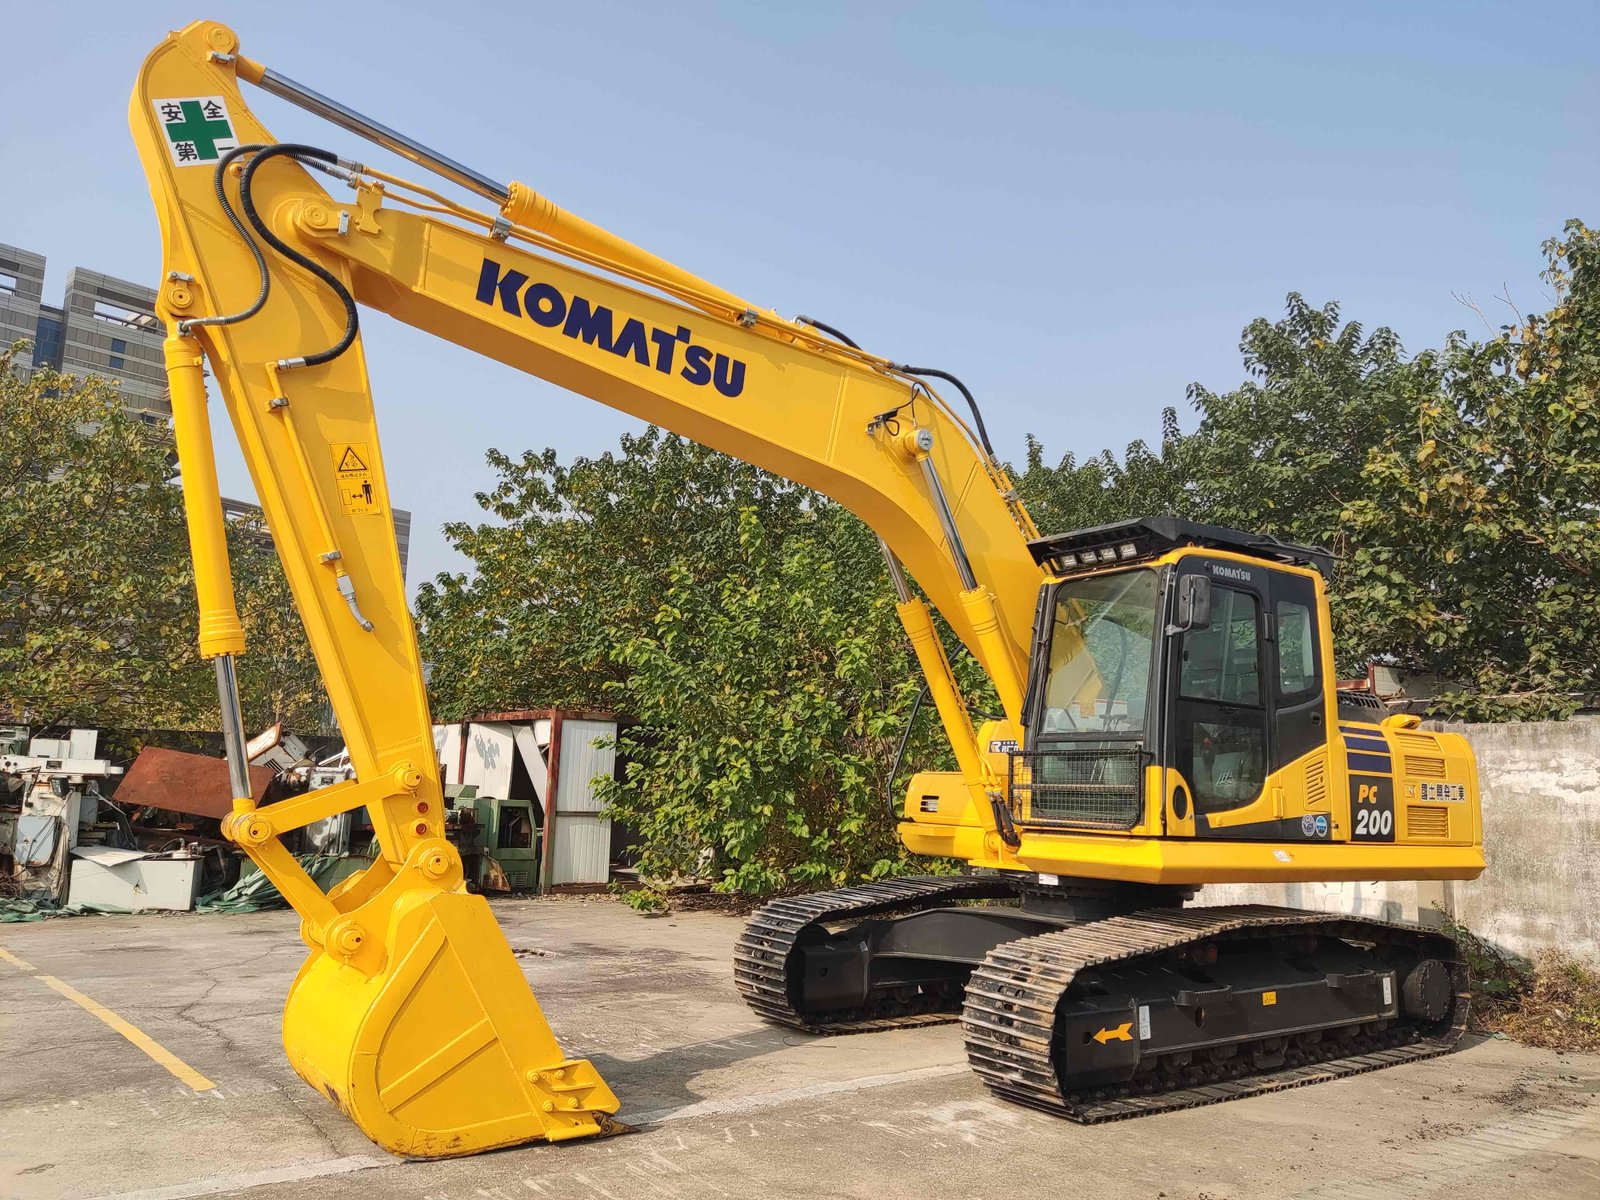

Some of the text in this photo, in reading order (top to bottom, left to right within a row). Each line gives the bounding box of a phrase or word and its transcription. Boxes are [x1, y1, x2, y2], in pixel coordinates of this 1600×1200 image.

[161, 100, 224, 122] 安全
[175, 142, 235, 162] 第一
[475, 257, 747, 398] KOMATSU
[1212, 564, 1251, 582] KOMATSU
[1358, 784, 1378, 804] PC
[1355, 809, 1393, 836] 200
